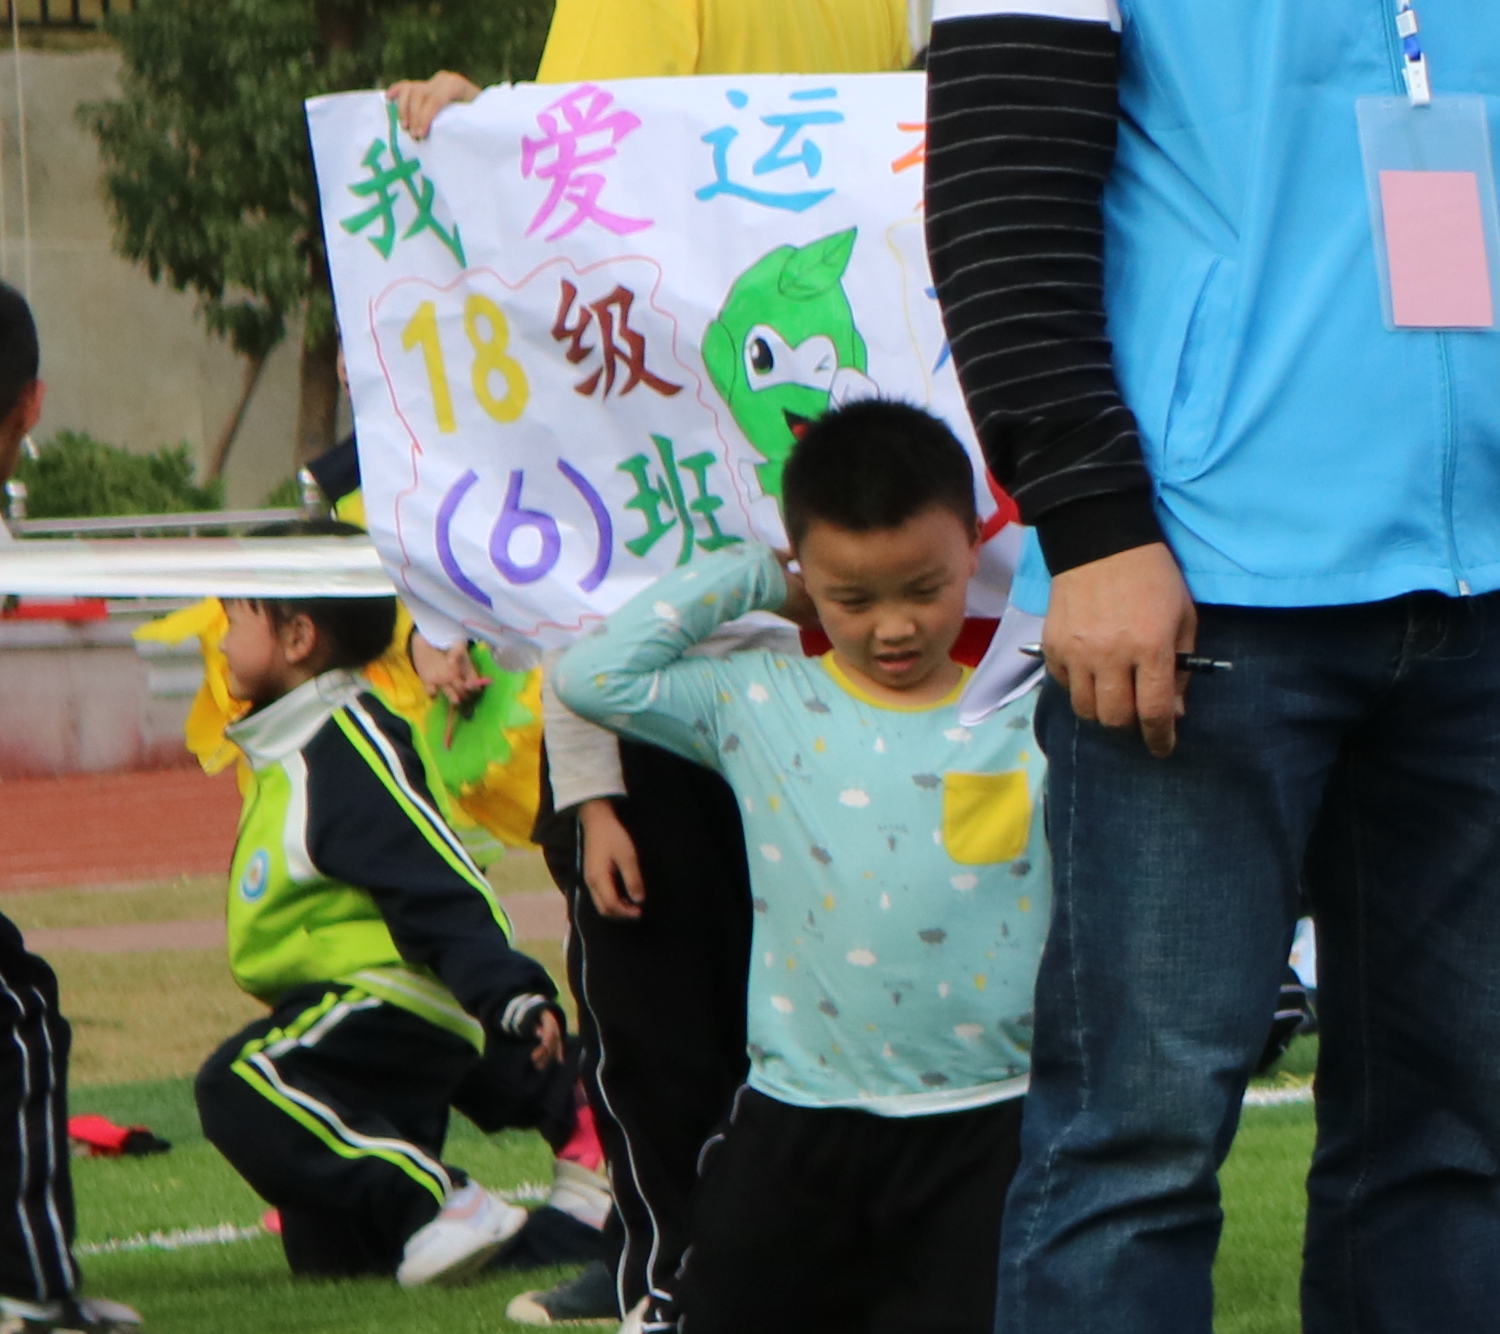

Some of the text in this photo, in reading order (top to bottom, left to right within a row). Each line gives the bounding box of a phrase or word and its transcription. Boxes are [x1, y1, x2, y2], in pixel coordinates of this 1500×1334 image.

[340, 83, 928, 269] 我爱运
[400, 279, 683, 434] 18级
[435, 432, 745, 610] (6)班
